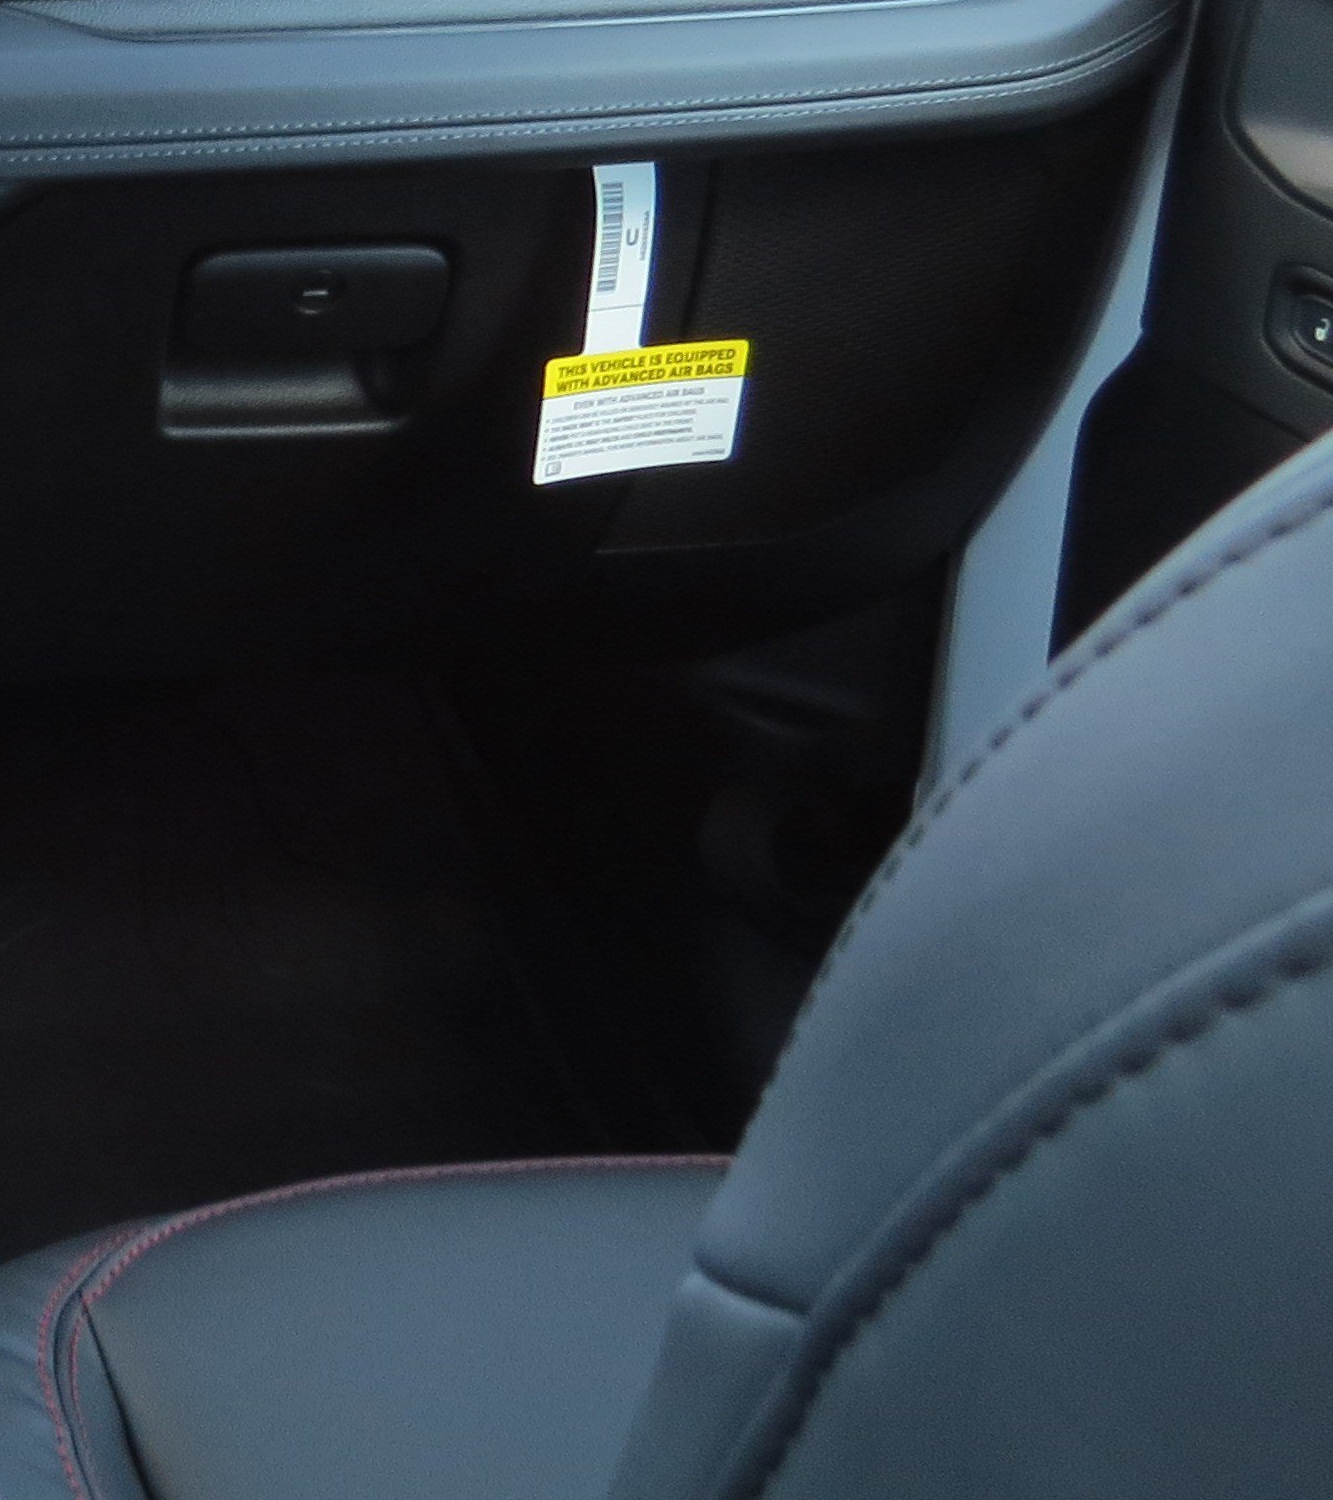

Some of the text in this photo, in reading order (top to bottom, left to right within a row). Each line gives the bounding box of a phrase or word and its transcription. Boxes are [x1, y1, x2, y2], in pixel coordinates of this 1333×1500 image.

[555, 362, 735, 394] WITH ADVANCED AIR BAGS
[557, 348, 736, 379] THIS VEHICLE IS EQUIPPED
